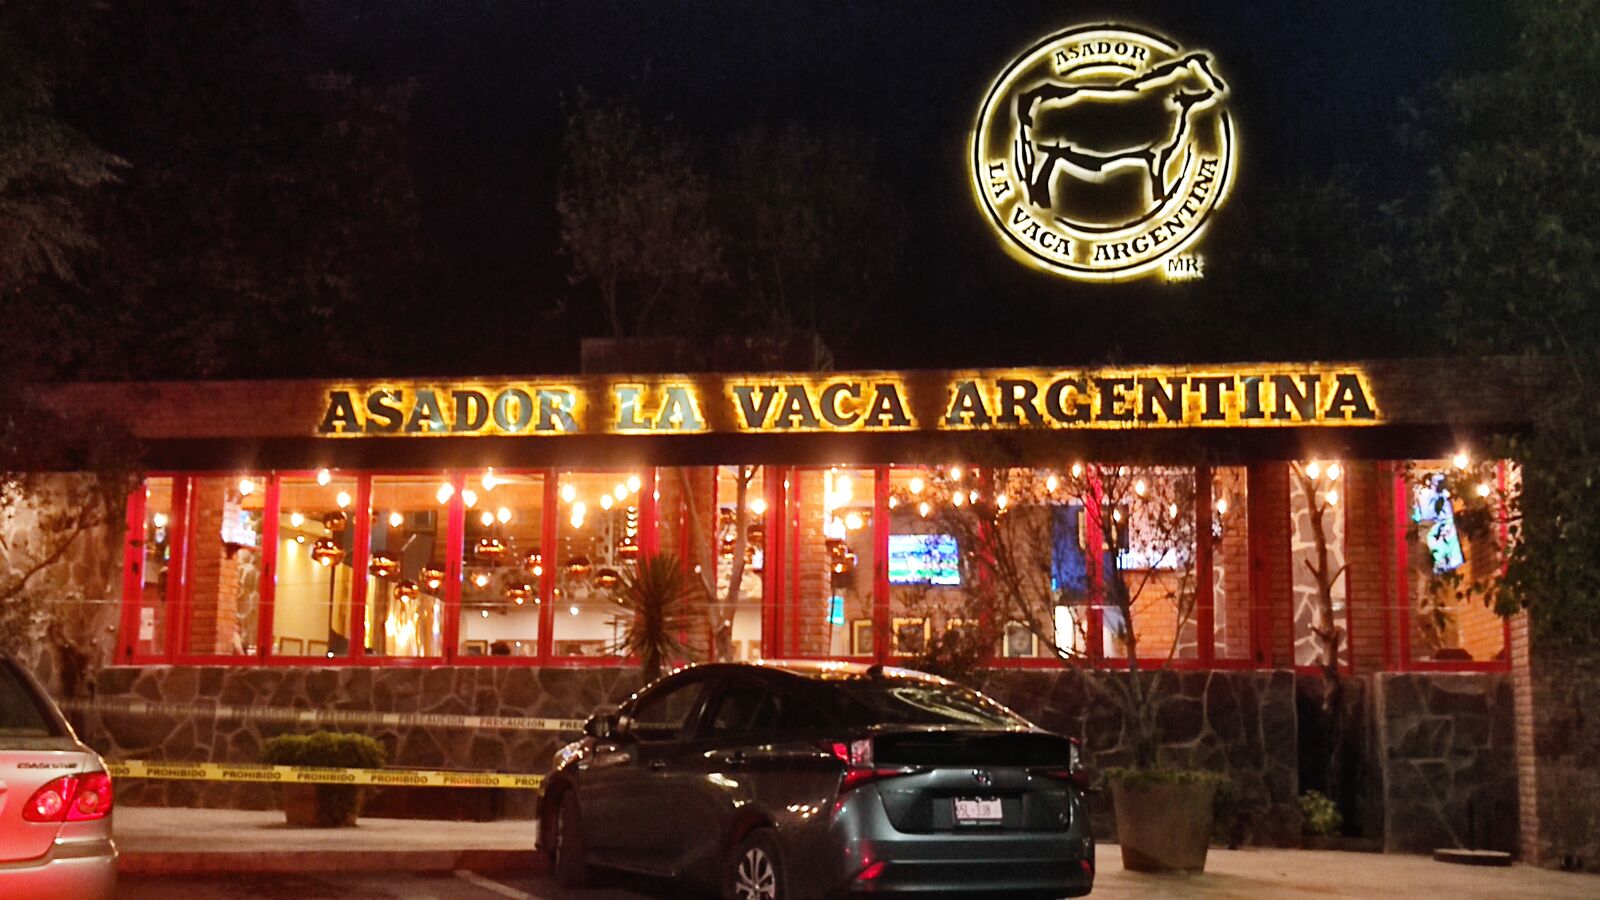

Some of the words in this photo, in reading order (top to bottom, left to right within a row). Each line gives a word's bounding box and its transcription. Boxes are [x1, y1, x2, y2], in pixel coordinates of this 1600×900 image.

[1056, 41, 1147, 66] ASADOR
[988, 161, 1011, 199] LA
[1011, 206, 1071, 257] VACA
[1094, 157, 1219, 262] ARGENTINA
[1168, 258, 1199, 272] MR
[317, 387, 579, 433] ASADOR
[614, 386, 707, 430] LA
[732, 382, 914, 429] VACA
[944, 373, 1377, 426] ARGENTINA
[146, 768, 207, 778] PROHIBIDO
[222, 770, 282, 780] PROHIBIDO
[296, 772, 356, 782] PROHIBIDO
[370, 775, 429, 785] PROHIBIDO
[443, 776, 500, 786] PROHIBIDO
